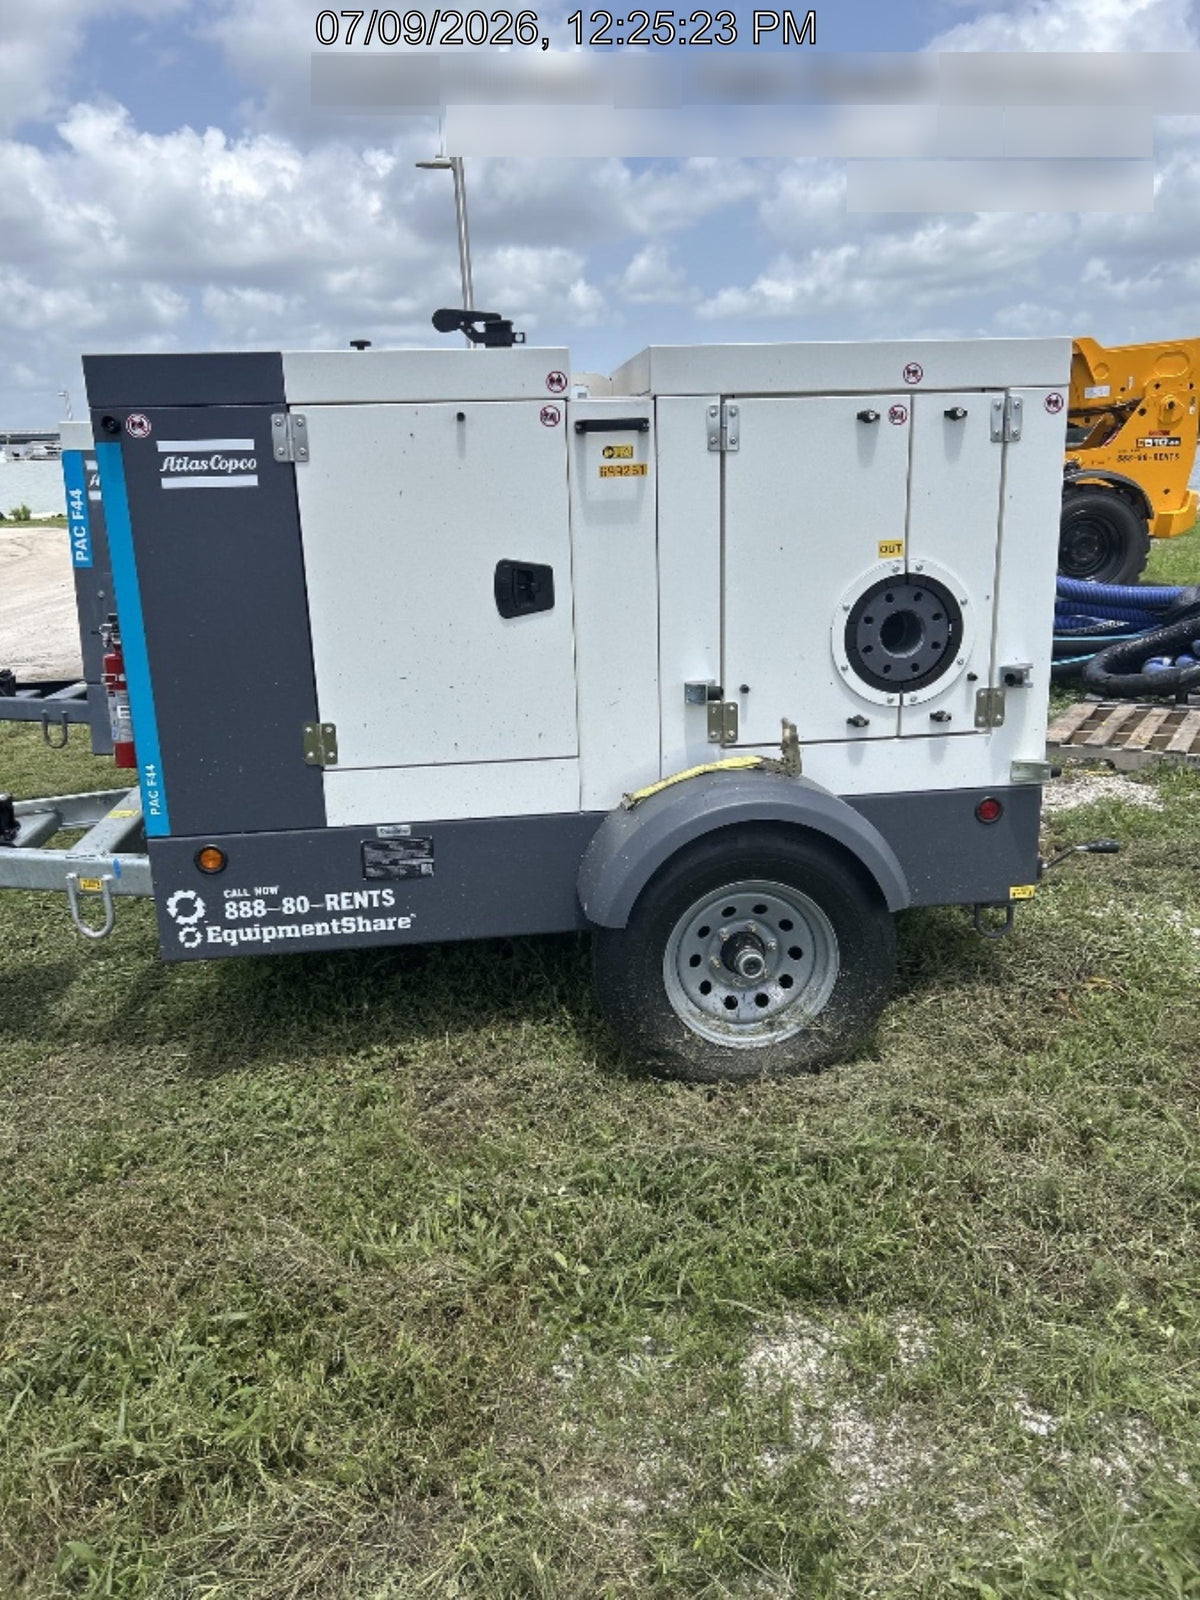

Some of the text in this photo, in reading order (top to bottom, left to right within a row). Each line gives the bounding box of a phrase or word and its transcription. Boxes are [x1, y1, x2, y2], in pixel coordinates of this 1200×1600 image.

[69, 488, 89, 561] PAC F44
[879, 543, 902, 553] OUT
[144, 763, 161, 815] PAC F44
[223, 885, 280, 899] CALL NOW
[224, 888, 396, 920] 888-80-RENTS
